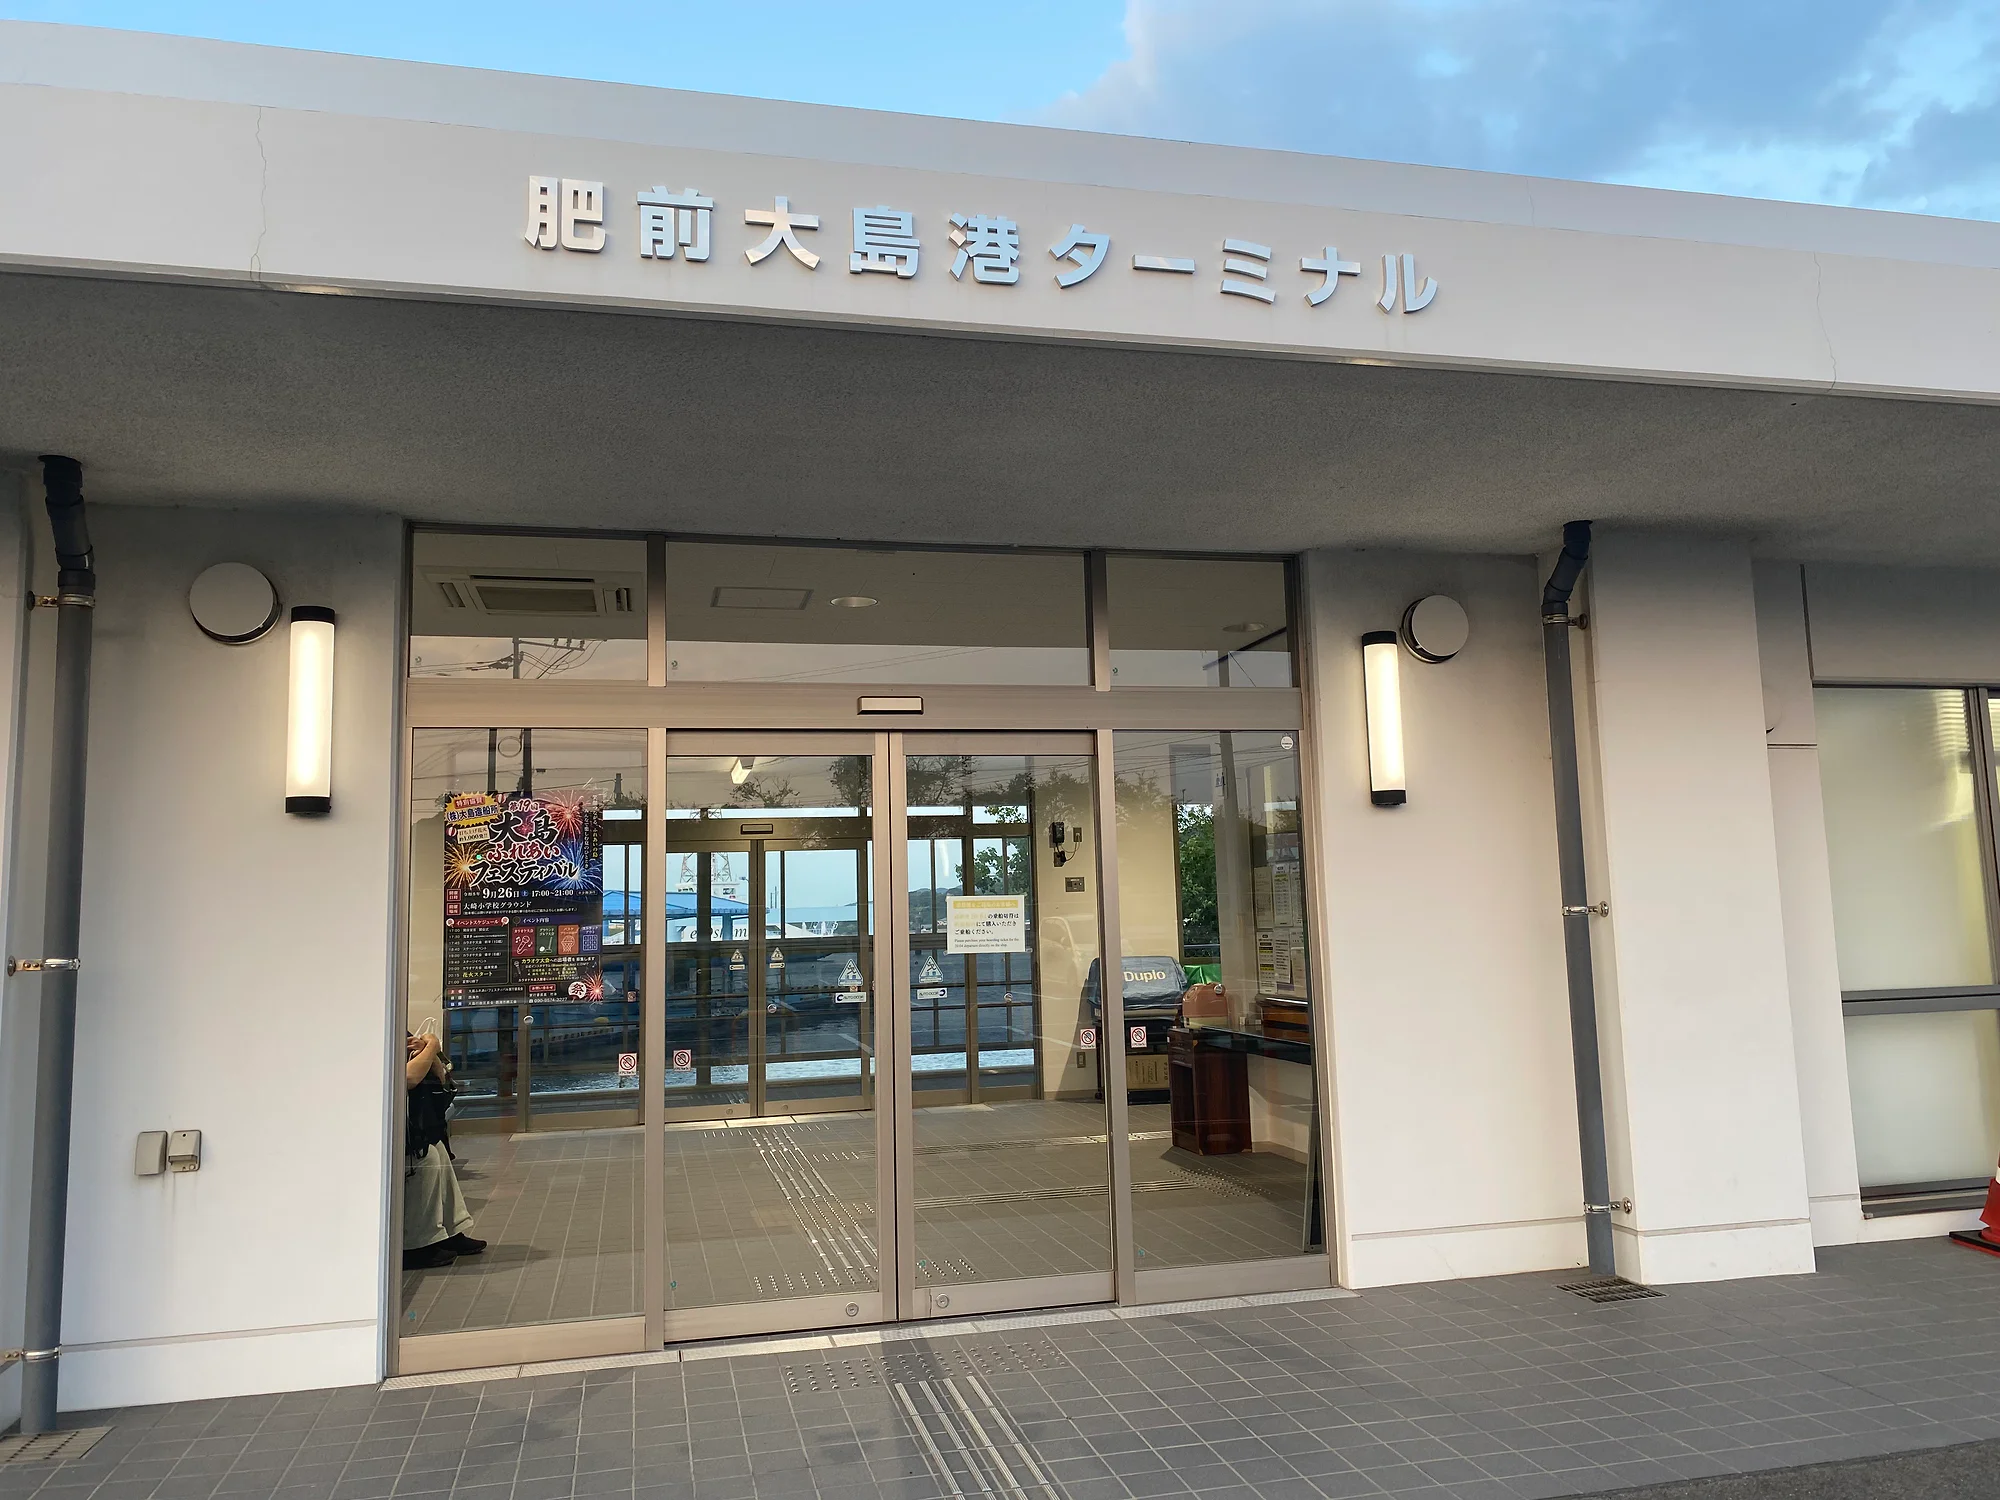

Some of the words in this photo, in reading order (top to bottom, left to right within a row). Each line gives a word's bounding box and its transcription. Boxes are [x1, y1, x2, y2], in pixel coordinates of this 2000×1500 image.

[524, 173, 1439, 315] 肥前大島港ターミナル
[489, 808, 560, 848] 大島
[486, 842, 562, 863] ふれあい
[468, 858, 580, 886] フェスティバル
[463, 901, 532, 910] 大崎小学校グラウンド
[1123, 969, 1166, 983] Duplo
